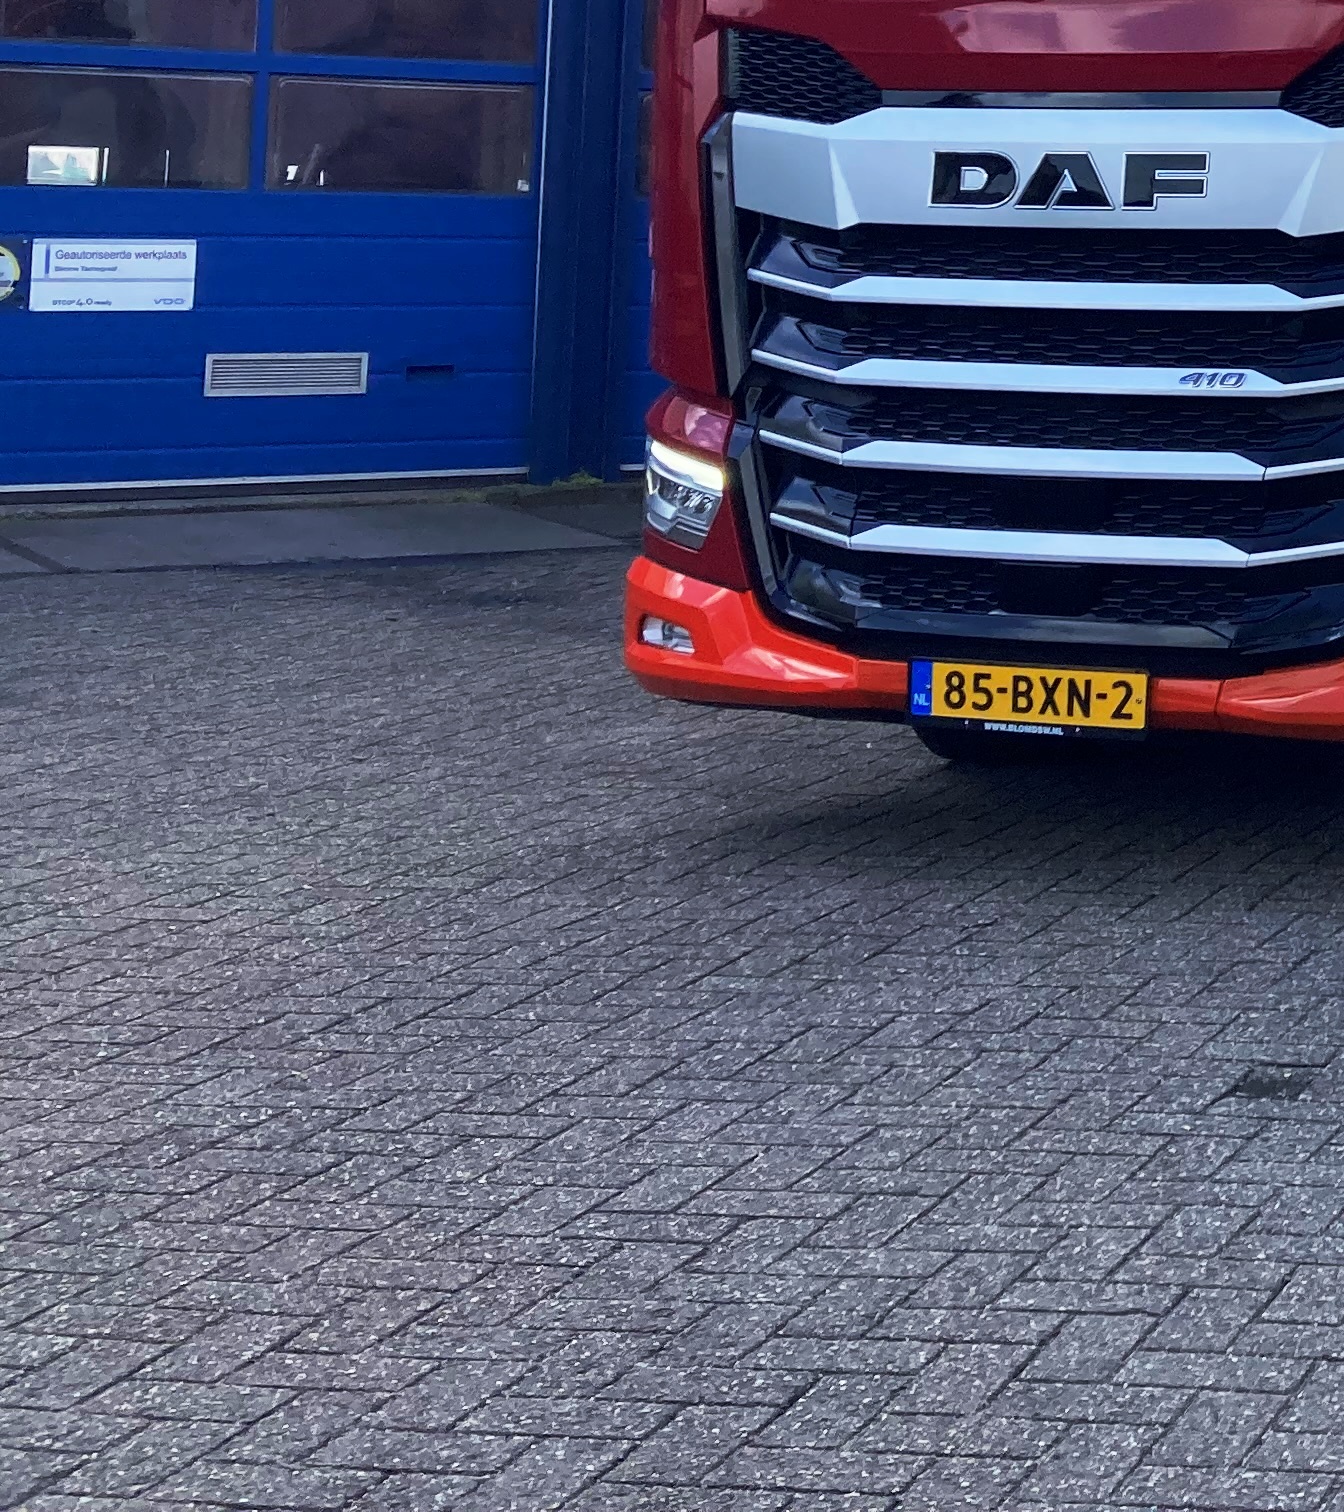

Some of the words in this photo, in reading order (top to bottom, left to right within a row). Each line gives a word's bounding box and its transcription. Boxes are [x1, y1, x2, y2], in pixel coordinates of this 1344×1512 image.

[928, 150, 1211, 211] DAF
[1178, 372, 1248, 388] 410
[912, 691, 931, 706] NL
[943, 670, 1134, 720] 85-BXN-2
